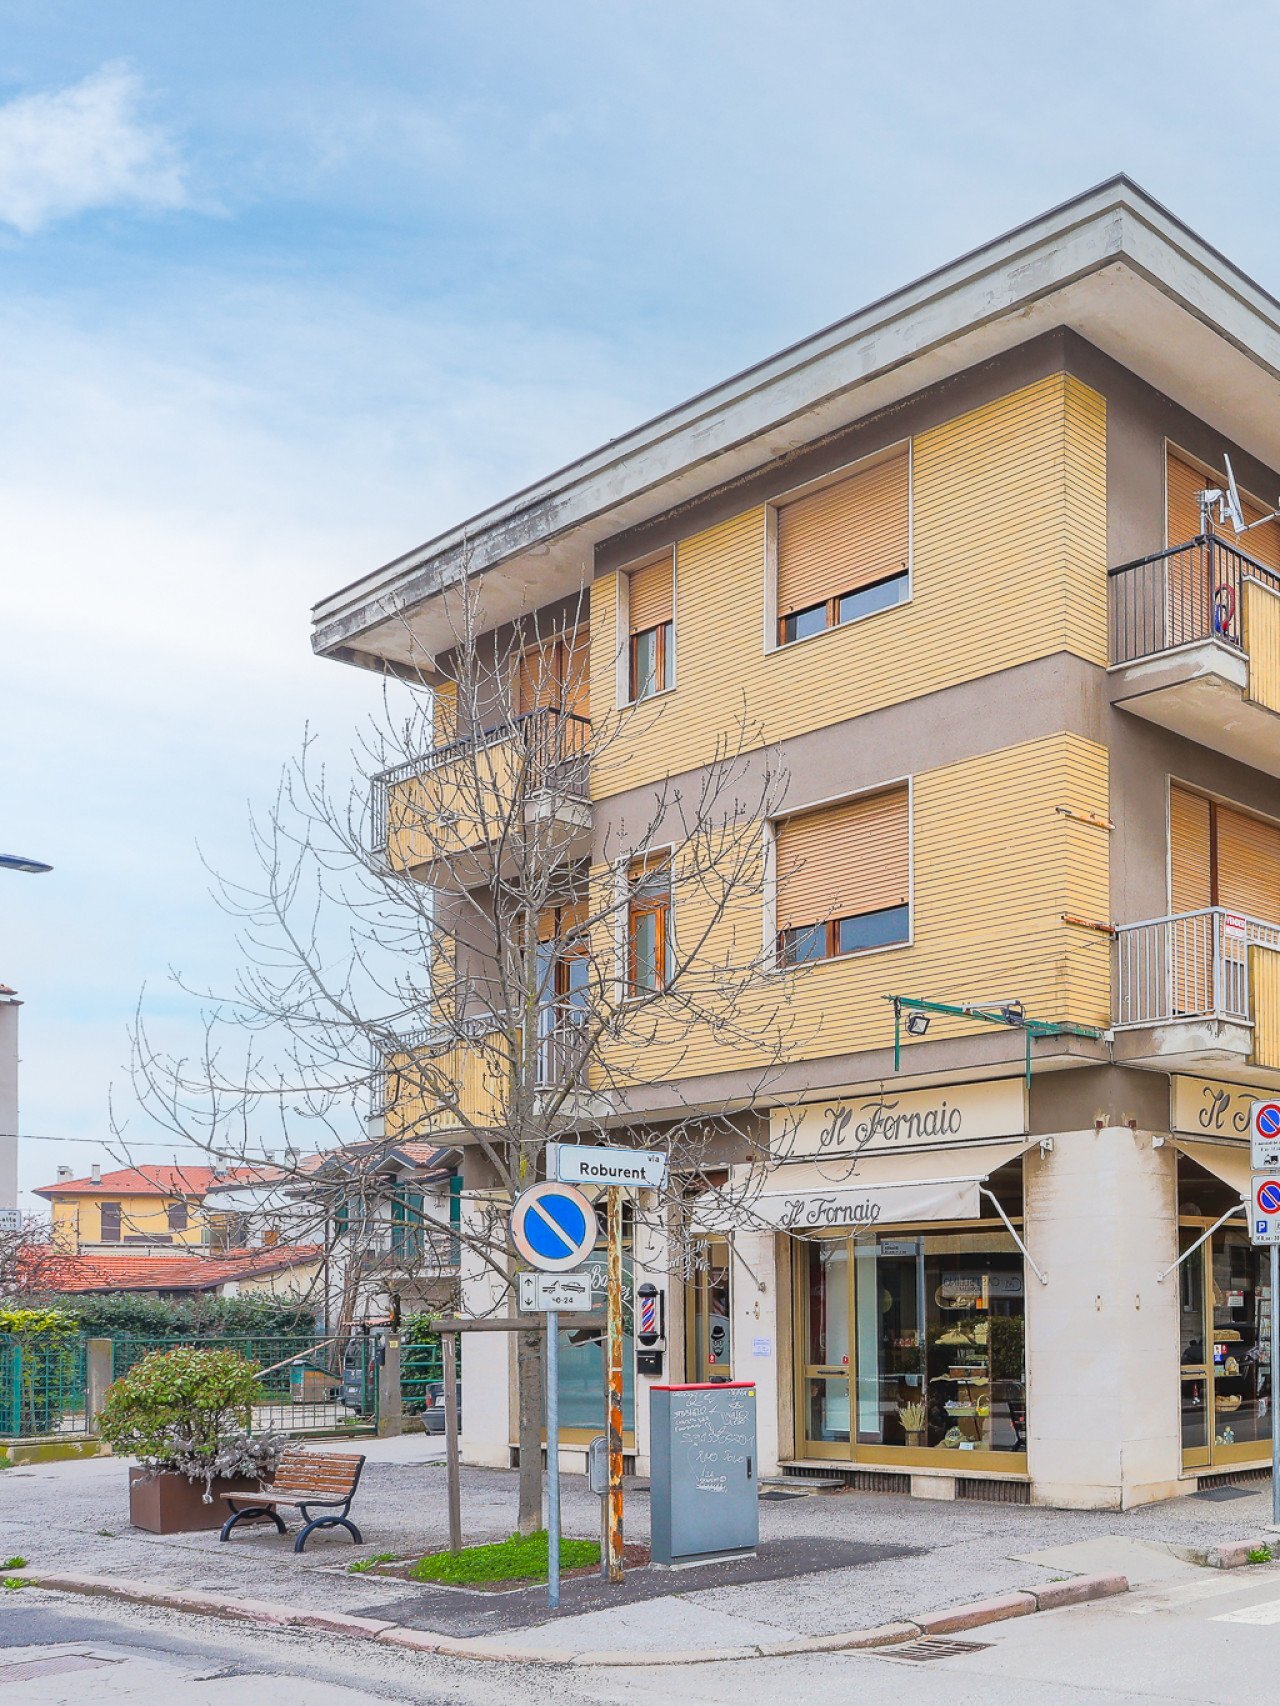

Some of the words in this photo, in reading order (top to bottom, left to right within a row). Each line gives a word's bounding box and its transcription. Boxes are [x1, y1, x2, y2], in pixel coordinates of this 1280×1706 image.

[1199, 1087, 1231, 1130] Il
[820, 1106, 853, 1146] Il
[855, 1100, 962, 1143] Fornaio
[579, 1161, 647, 1179] Roburent
[647, 1155, 660, 1163] via
[779, 1200, 805, 1227] Il
[805, 1197, 881, 1225] Fornaio
[1258, 1221, 1266, 1232] P
